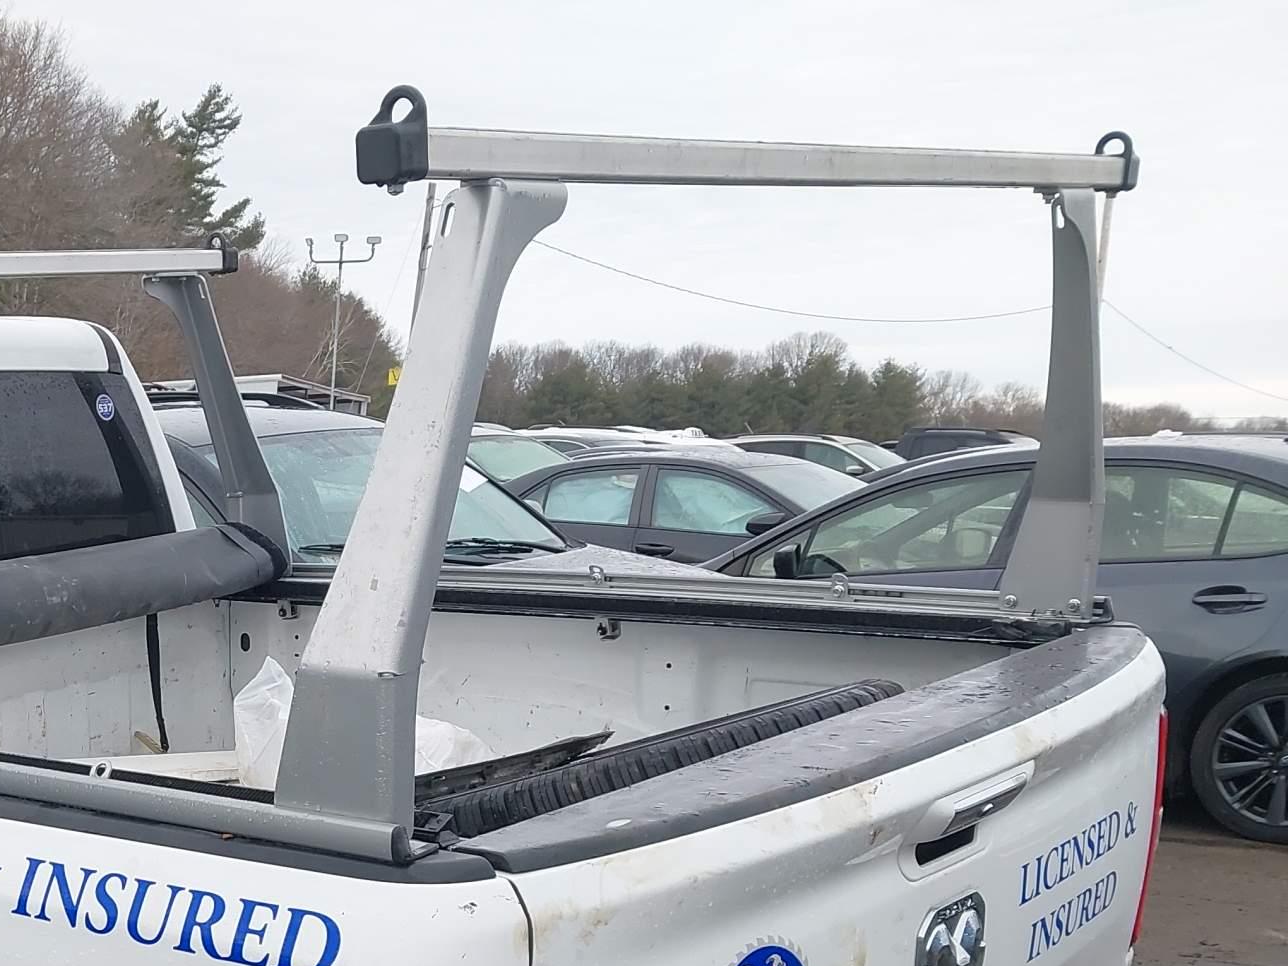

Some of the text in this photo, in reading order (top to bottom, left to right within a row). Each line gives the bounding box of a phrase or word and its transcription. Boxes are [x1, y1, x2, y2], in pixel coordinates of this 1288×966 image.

[98, 403, 112, 413] 537
[1018, 801, 1138, 906] LICENSED &
[1026, 870, 1118, 963] INSURED
